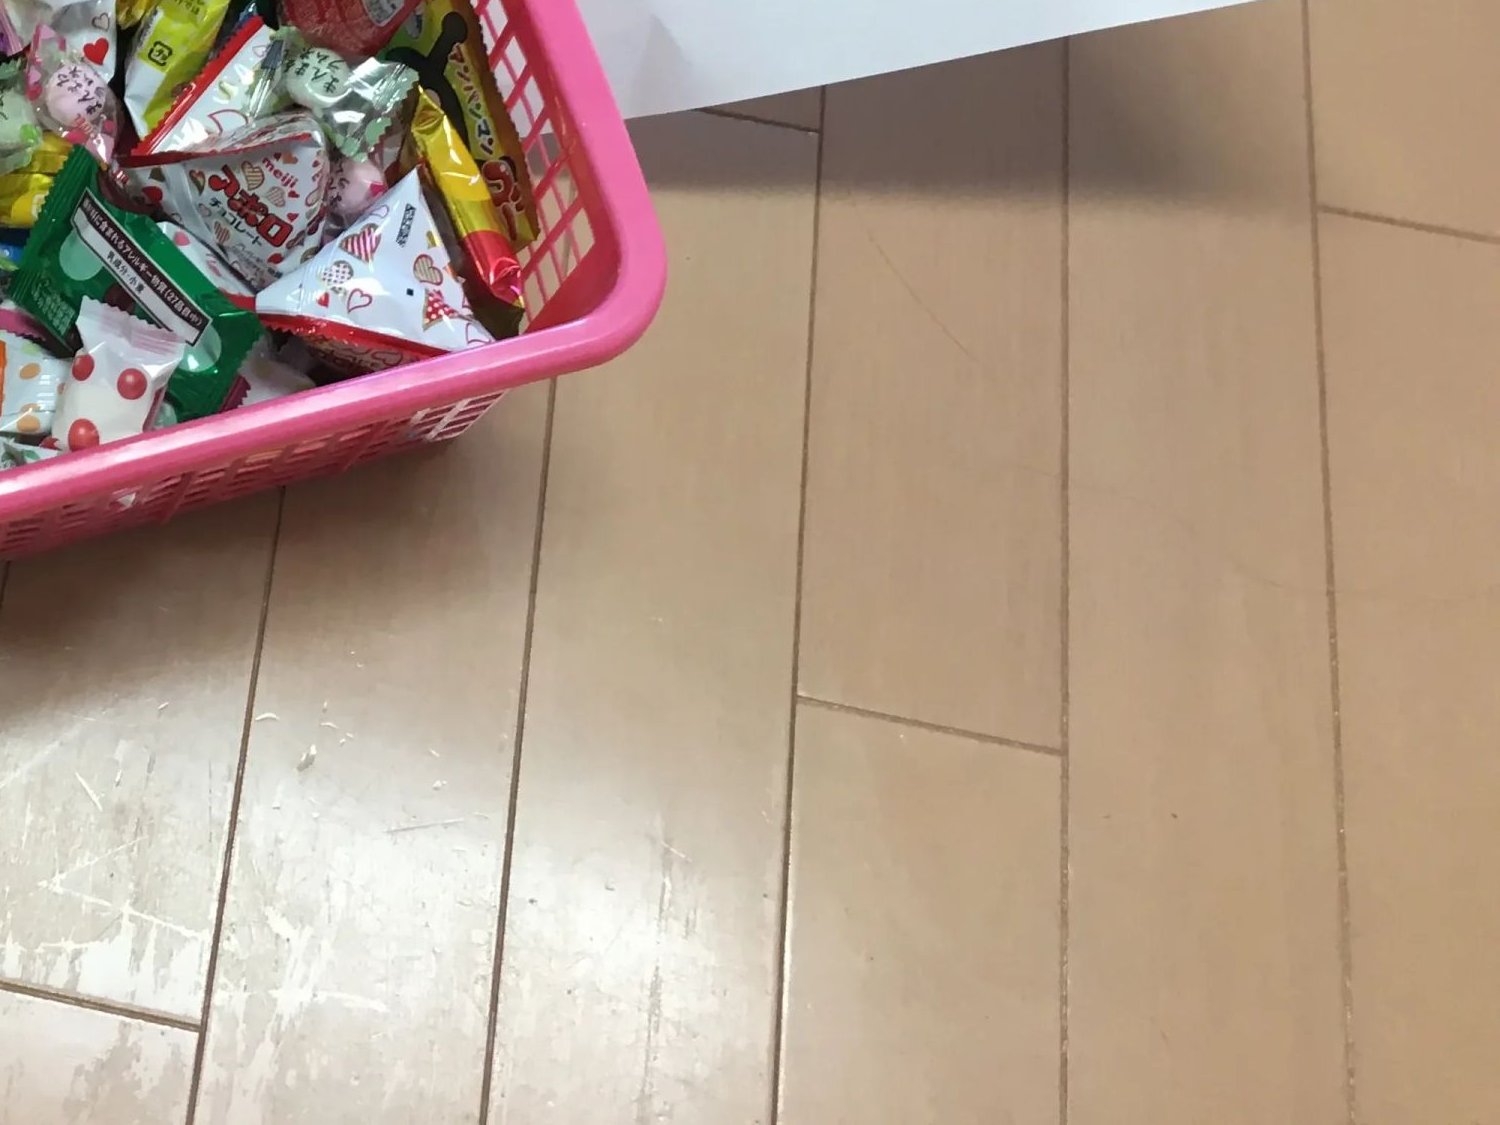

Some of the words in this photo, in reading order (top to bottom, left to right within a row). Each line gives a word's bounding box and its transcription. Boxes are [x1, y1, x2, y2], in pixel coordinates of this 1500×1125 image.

[449, 43, 494, 156] アンパンマン
[208, 164, 294, 248] アポロ
[262, 157, 299, 190] meiji
[208, 195, 263, 248] チョコレート
